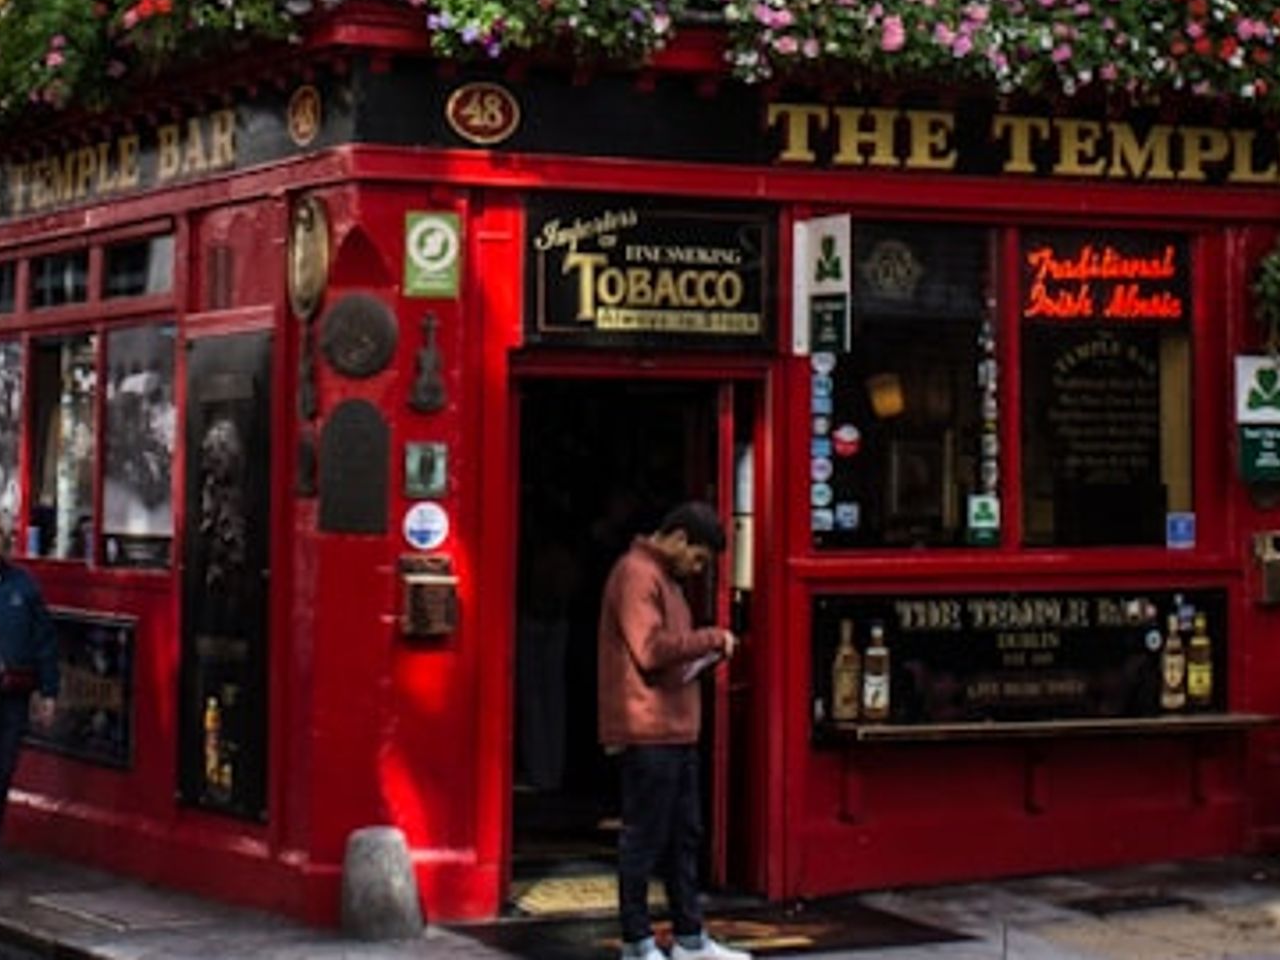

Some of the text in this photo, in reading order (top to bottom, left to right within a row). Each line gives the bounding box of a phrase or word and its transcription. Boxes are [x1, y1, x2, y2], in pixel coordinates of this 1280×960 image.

[462, 91, 506, 127] 48
[766, 103, 958, 171] THE
[8, 135, 141, 213] TEMPLE
[157, 109, 238, 178] BAR
[1027, 243, 1177, 280] Traditional
[563, 251, 744, 321] TOBACCO
[1024, 282, 1183, 319] Irish Music
[895, 600, 962, 630] THE
[966, 599, 1091, 629] TEMPLE
